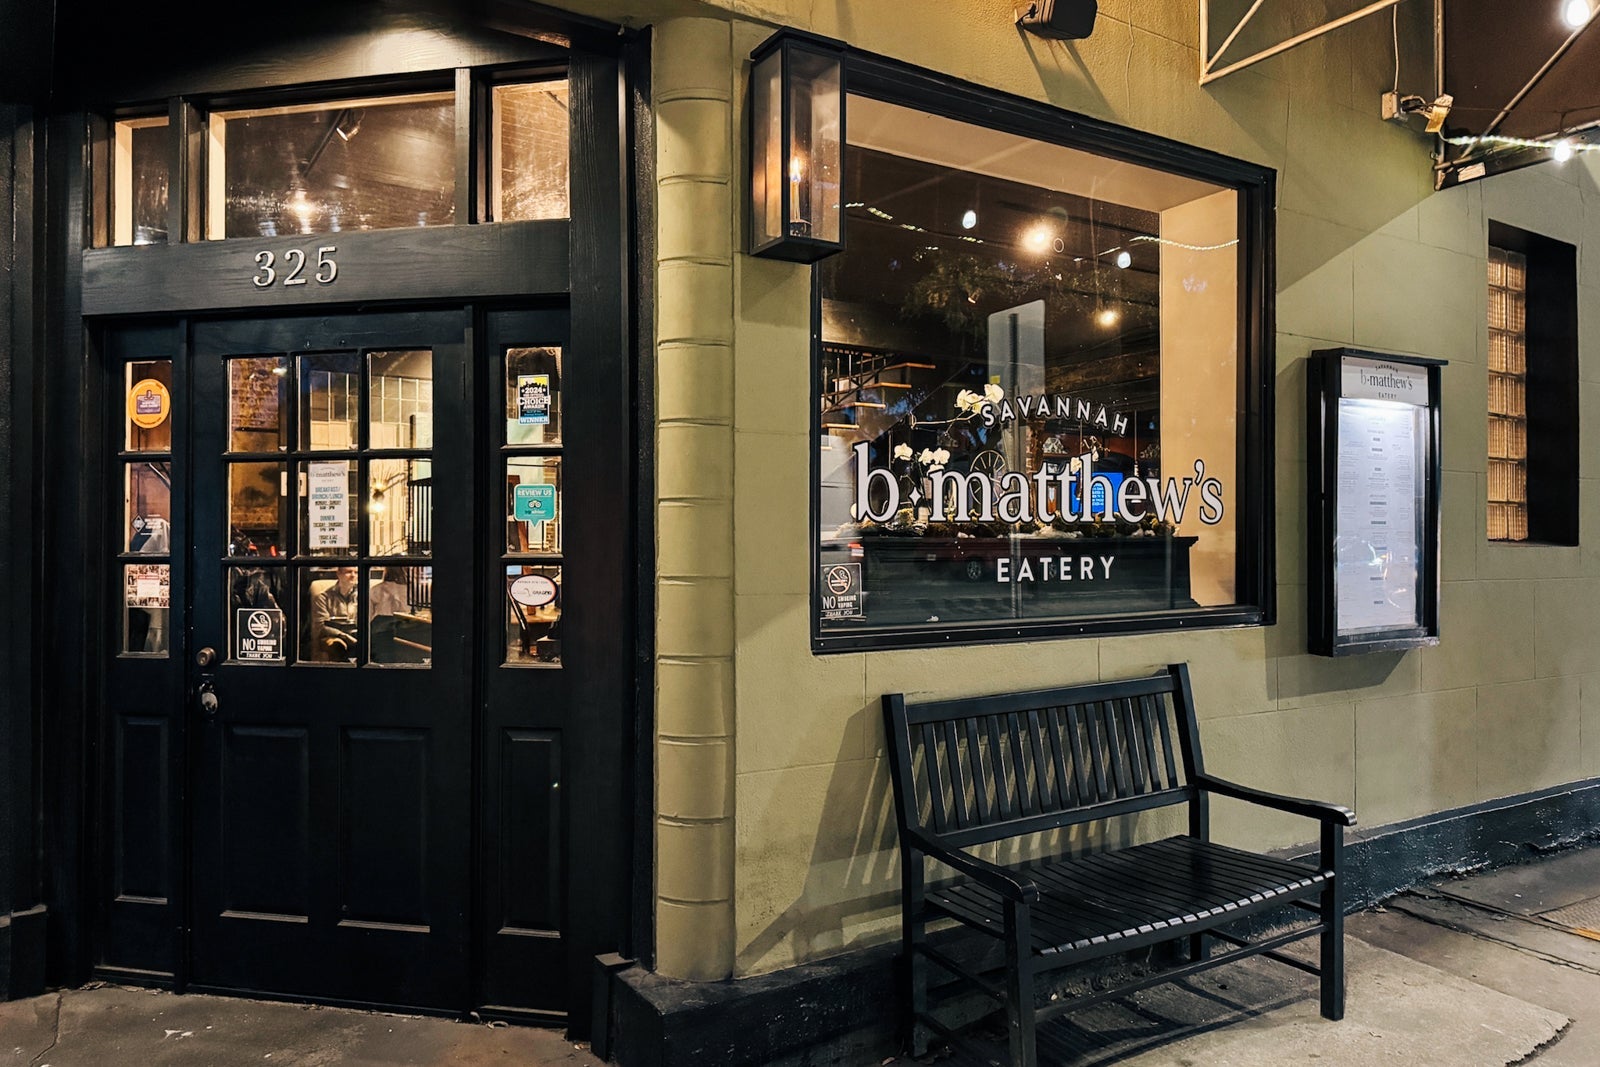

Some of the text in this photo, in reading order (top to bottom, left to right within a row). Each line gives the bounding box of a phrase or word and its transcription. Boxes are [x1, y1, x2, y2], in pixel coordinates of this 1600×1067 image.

[252, 246, 338, 287] 325
[982, 395, 1128, 436] SAVANNAH
[518, 488, 552, 496] REVIEW US
[997, 556, 1115, 583] EATERY
[823, 596, 836, 609] NO
[242, 638, 256, 651] NO
